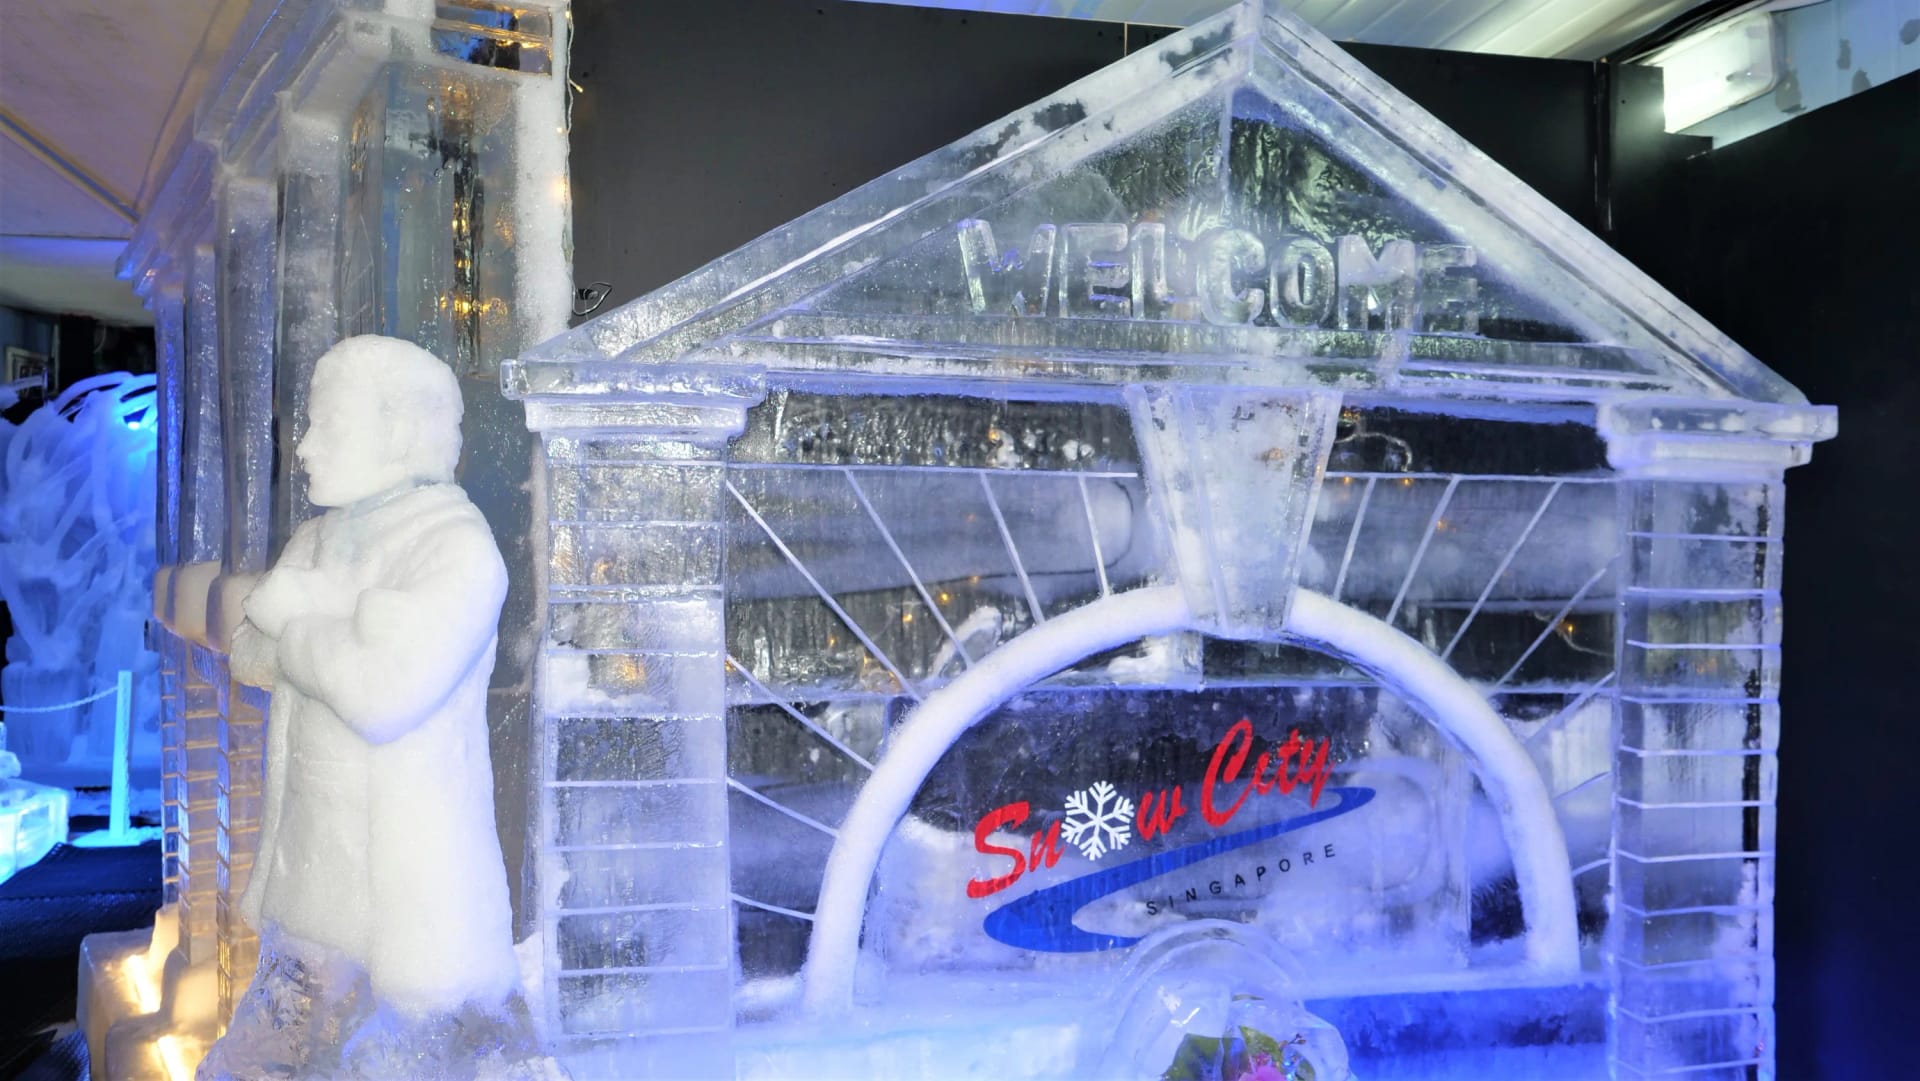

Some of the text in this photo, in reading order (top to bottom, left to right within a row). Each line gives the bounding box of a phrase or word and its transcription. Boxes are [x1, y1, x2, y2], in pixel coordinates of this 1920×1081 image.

[956, 218, 1479, 335] WELCOME
[1200, 719, 1335, 828] City
[1145, 843, 1336, 917] SINGAPORE
